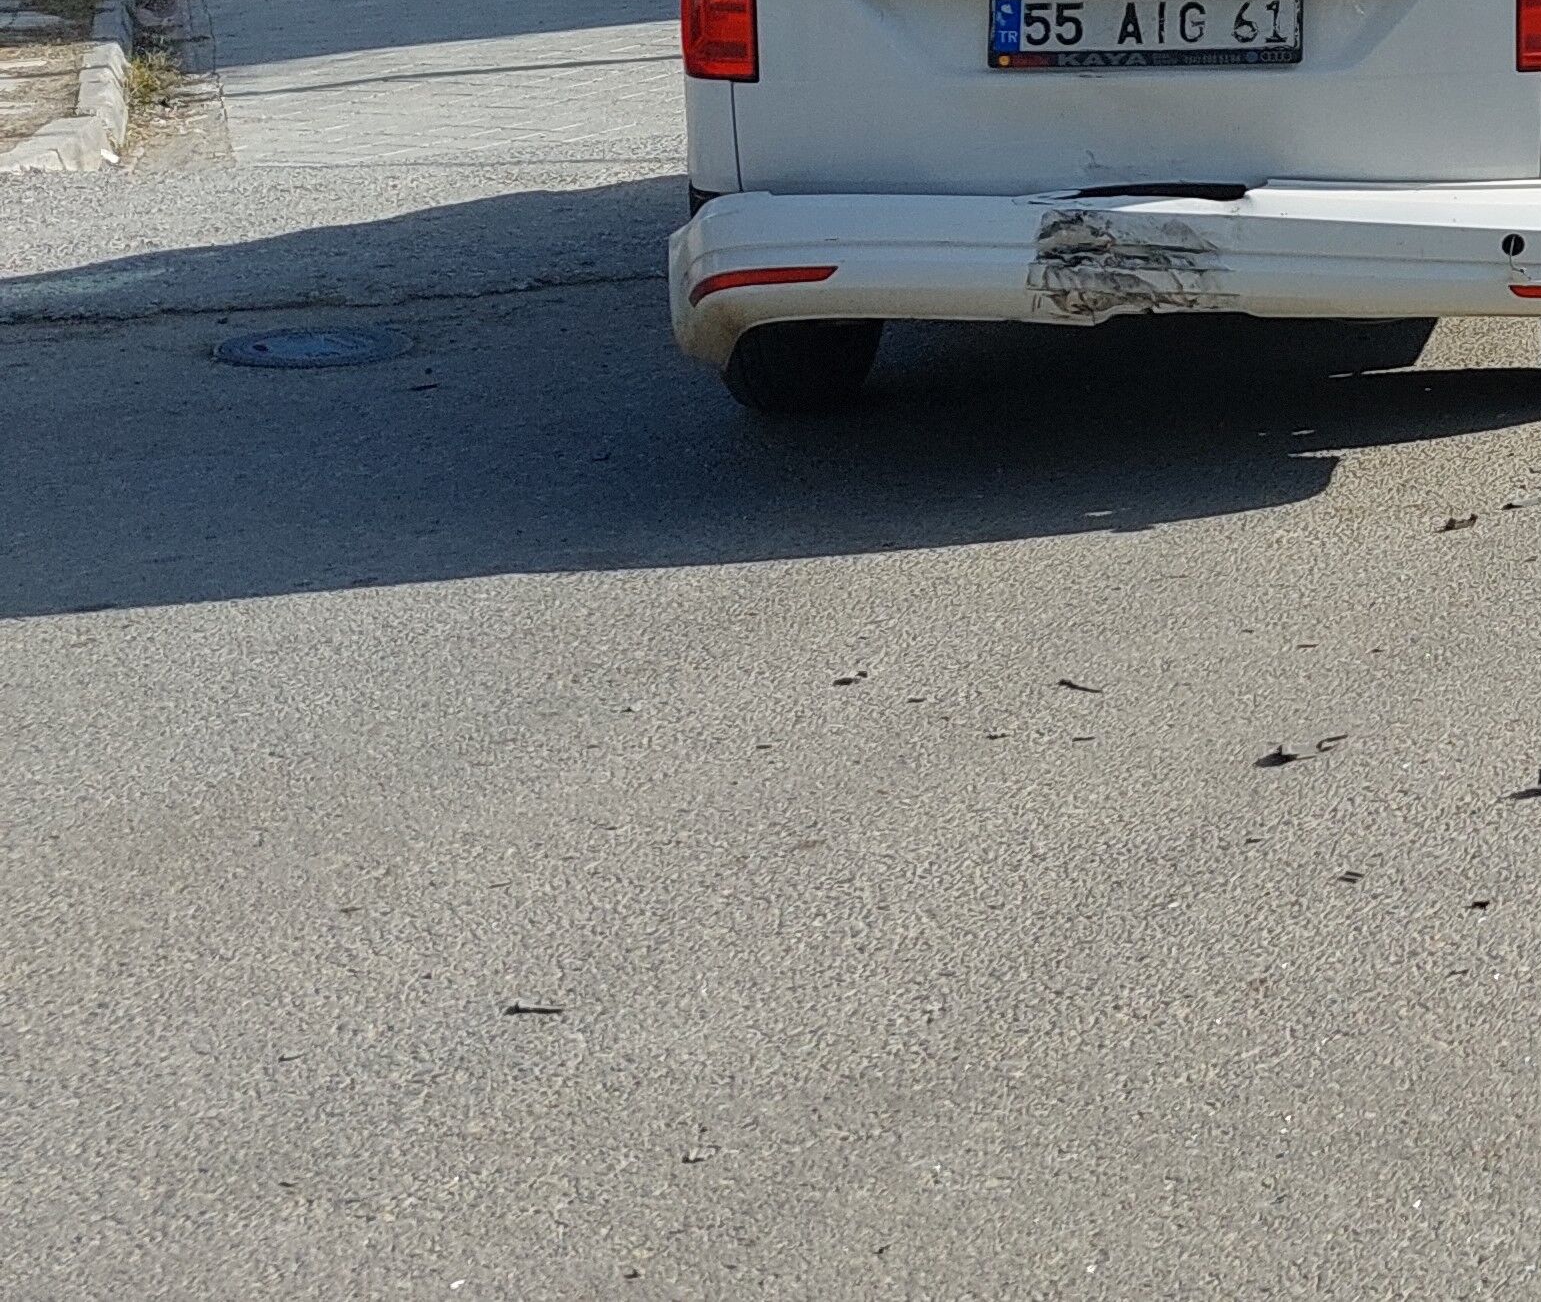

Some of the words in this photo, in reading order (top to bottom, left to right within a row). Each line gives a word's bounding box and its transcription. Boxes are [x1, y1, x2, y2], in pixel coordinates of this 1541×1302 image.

[1025, 1, 1084, 46] 55
[1117, 1, 1206, 45] AIG
[1232, 0, 1288, 44] 61
[999, 30, 1018, 43] TR
[1057, 52, 1148, 67] KAYA
